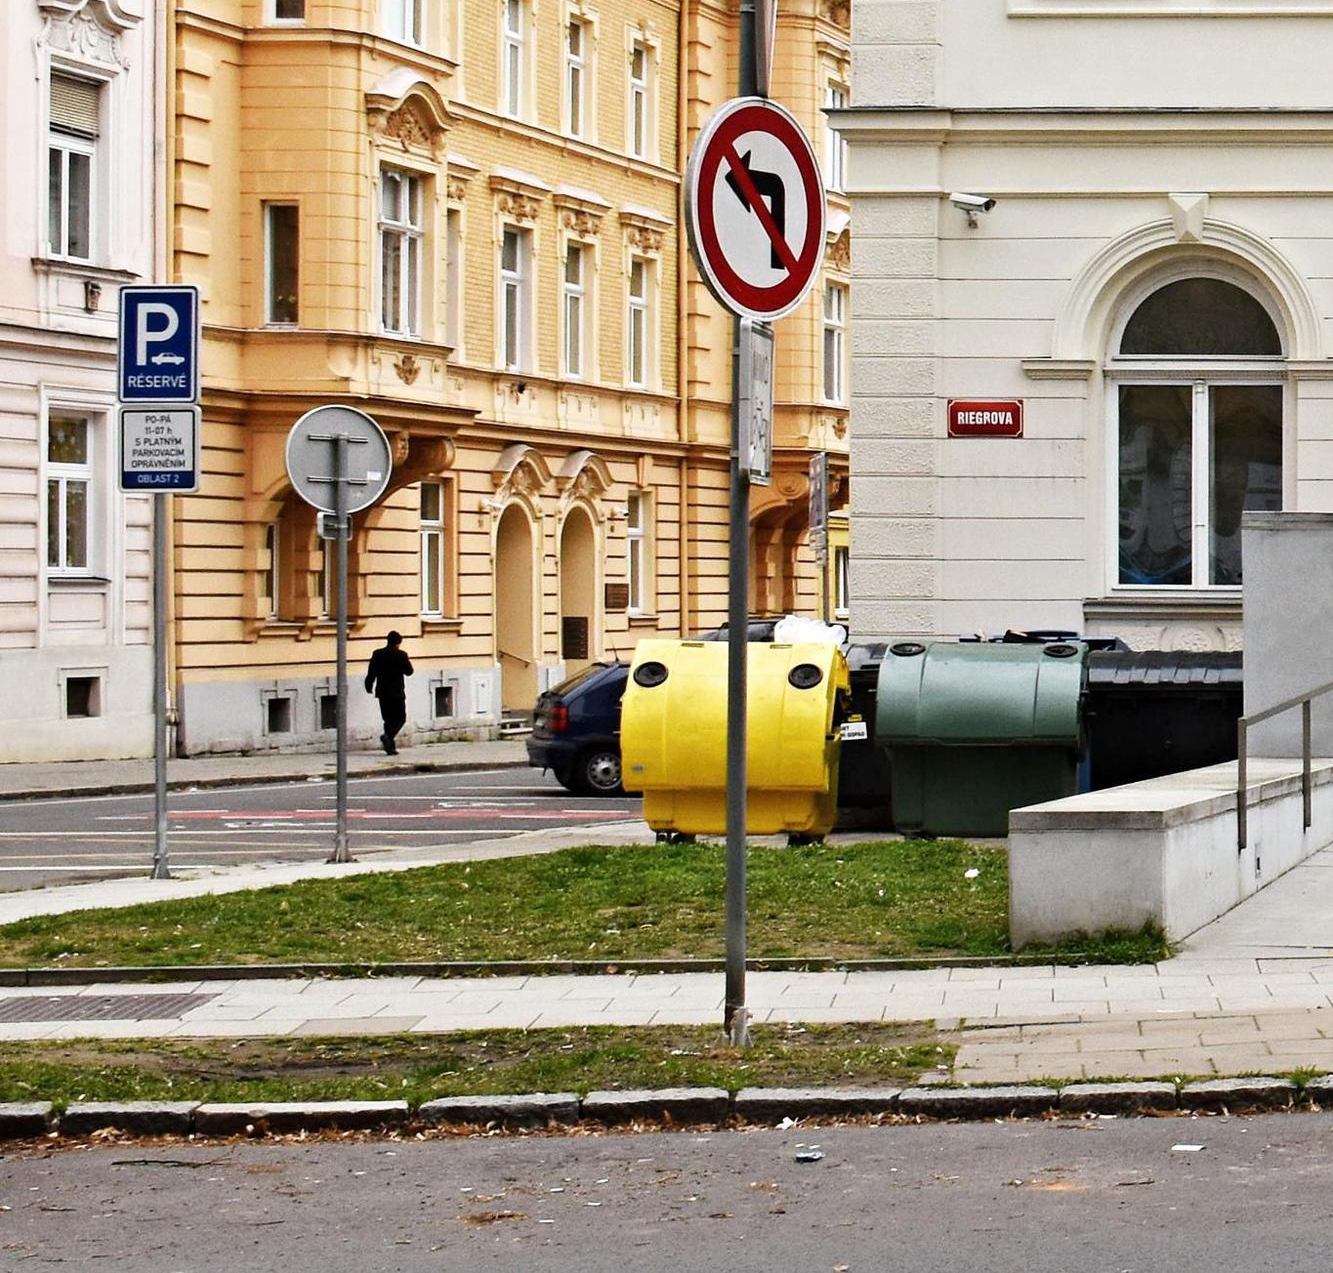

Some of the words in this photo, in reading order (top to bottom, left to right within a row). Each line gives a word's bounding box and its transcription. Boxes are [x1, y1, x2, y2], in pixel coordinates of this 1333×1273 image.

[136, 302, 179, 366] P
[128, 372, 187, 388] RÉSERVÉ
[145, 414, 171, 424] PO-PÁ
[957, 411, 1013, 425] RIEGROVA
[135, 437, 141, 446] S
[137, 474, 171, 484] OBLAST
[173, 474, 180, 484] 2
